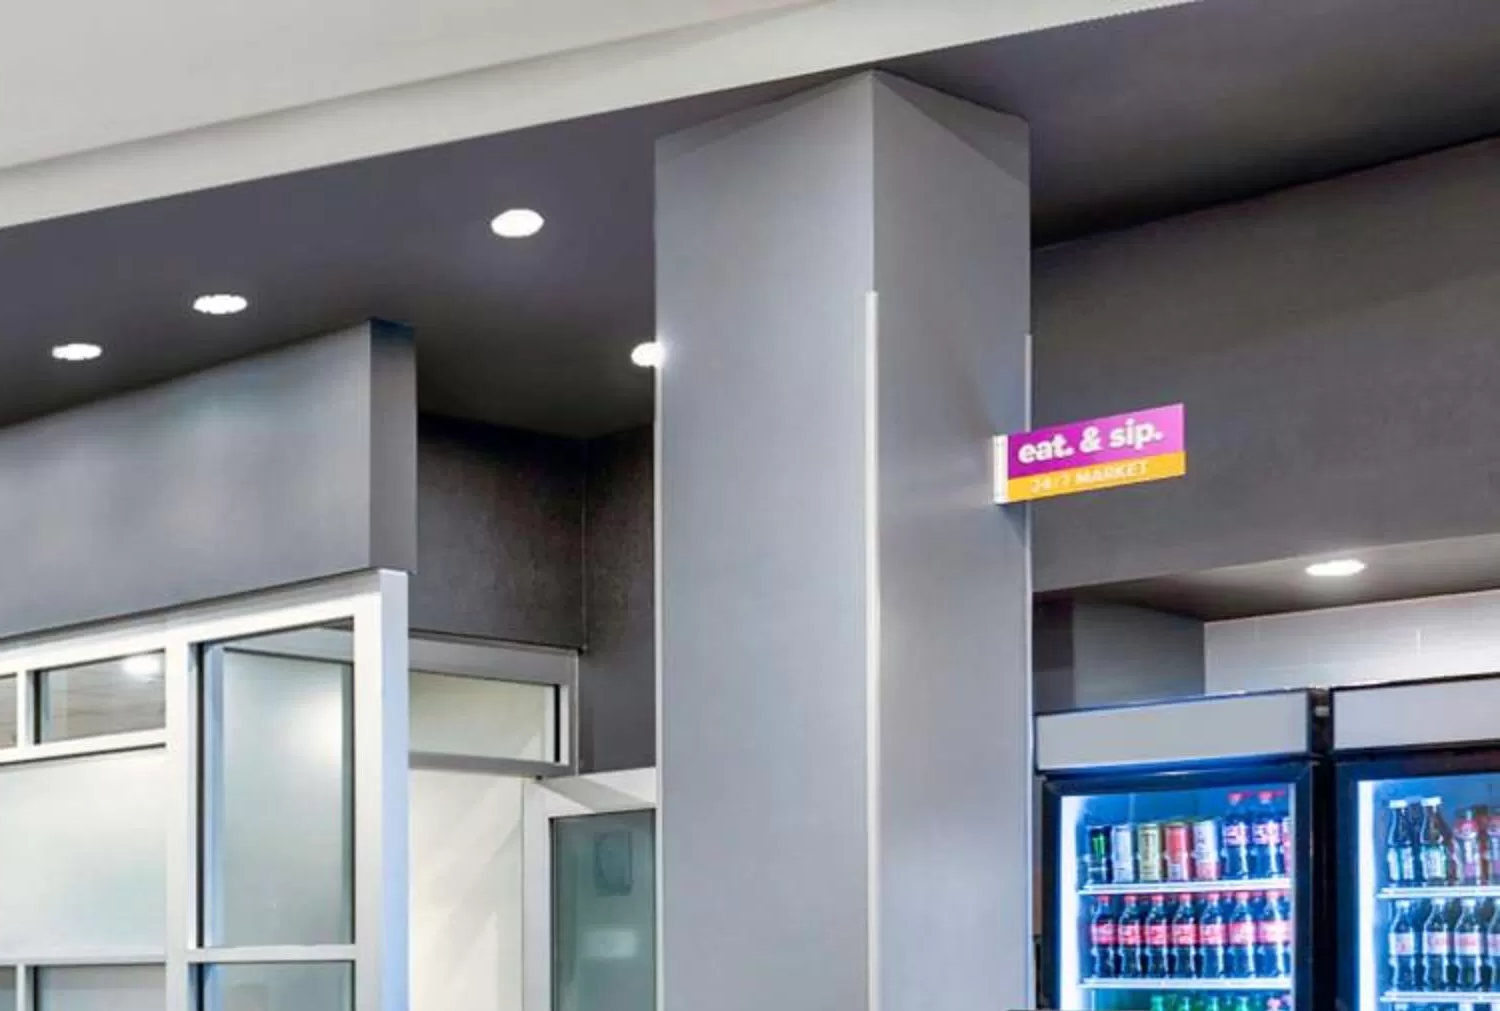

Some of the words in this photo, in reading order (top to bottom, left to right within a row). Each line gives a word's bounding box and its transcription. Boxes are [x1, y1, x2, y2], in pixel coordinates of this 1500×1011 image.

[1017, 433, 1075, 464] eat.
[1079, 425, 1104, 454] &
[1108, 417, 1164, 450] sip.
[1074, 460, 1150, 485] MARKET
